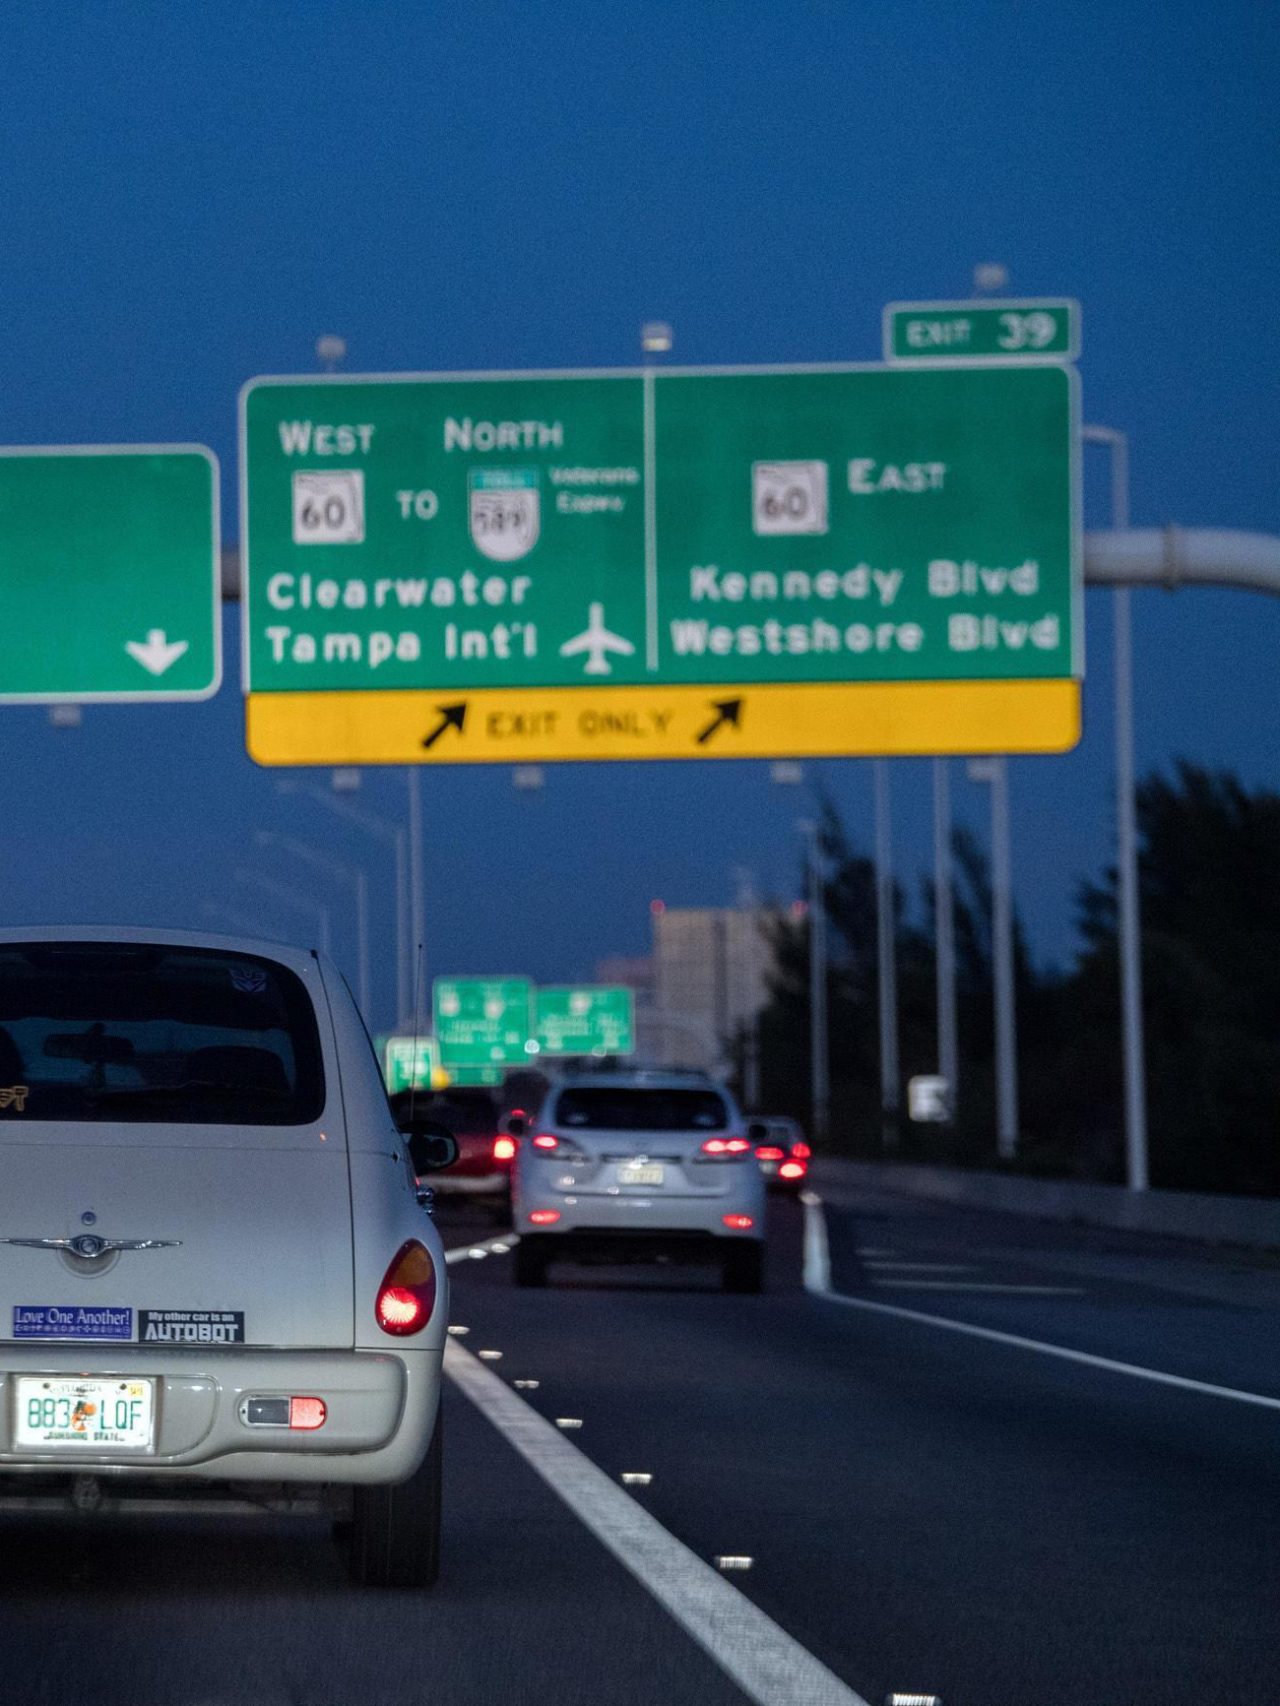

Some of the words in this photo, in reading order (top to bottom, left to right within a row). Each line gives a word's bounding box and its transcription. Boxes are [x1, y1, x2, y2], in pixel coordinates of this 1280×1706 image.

[906, 319, 971, 347] EXIT
[996, 311, 1057, 349] 39
[278, 419, 375, 455] WEST
[443, 416, 564, 452] NORTH
[847, 457, 947, 494] EAST
[301, 496, 346, 530] 60
[397, 489, 439, 520] TO
[762, 486, 809, 520] 60
[267, 571, 532, 610] Clearwater
[690, 563, 903, 607] Kennedy
[927, 559, 1039, 598] Blvd
[265, 625, 421, 669] Tampa
[444, 622, 538, 660] Int'l
[670, 618, 924, 656] Westshore
[948, 613, 1060, 652] Blvd
[486, 711, 556, 739] EXIT
[577, 709, 675, 738] ONLY
[16, 1308, 45, 1323] Love
[48, 1308, 74, 1324] One
[77, 1308, 130, 1326] Another!
[145, 1322, 239, 1341] AUTOBOT
[148, 1312, 163, 1321] My
[164, 1312, 191, 1321] other
[210, 1313, 220, 1321] is
[221, 1314, 235, 1322] an
[28, 1398, 70, 1428] 883
[100, 1400, 143, 1430] LQF
